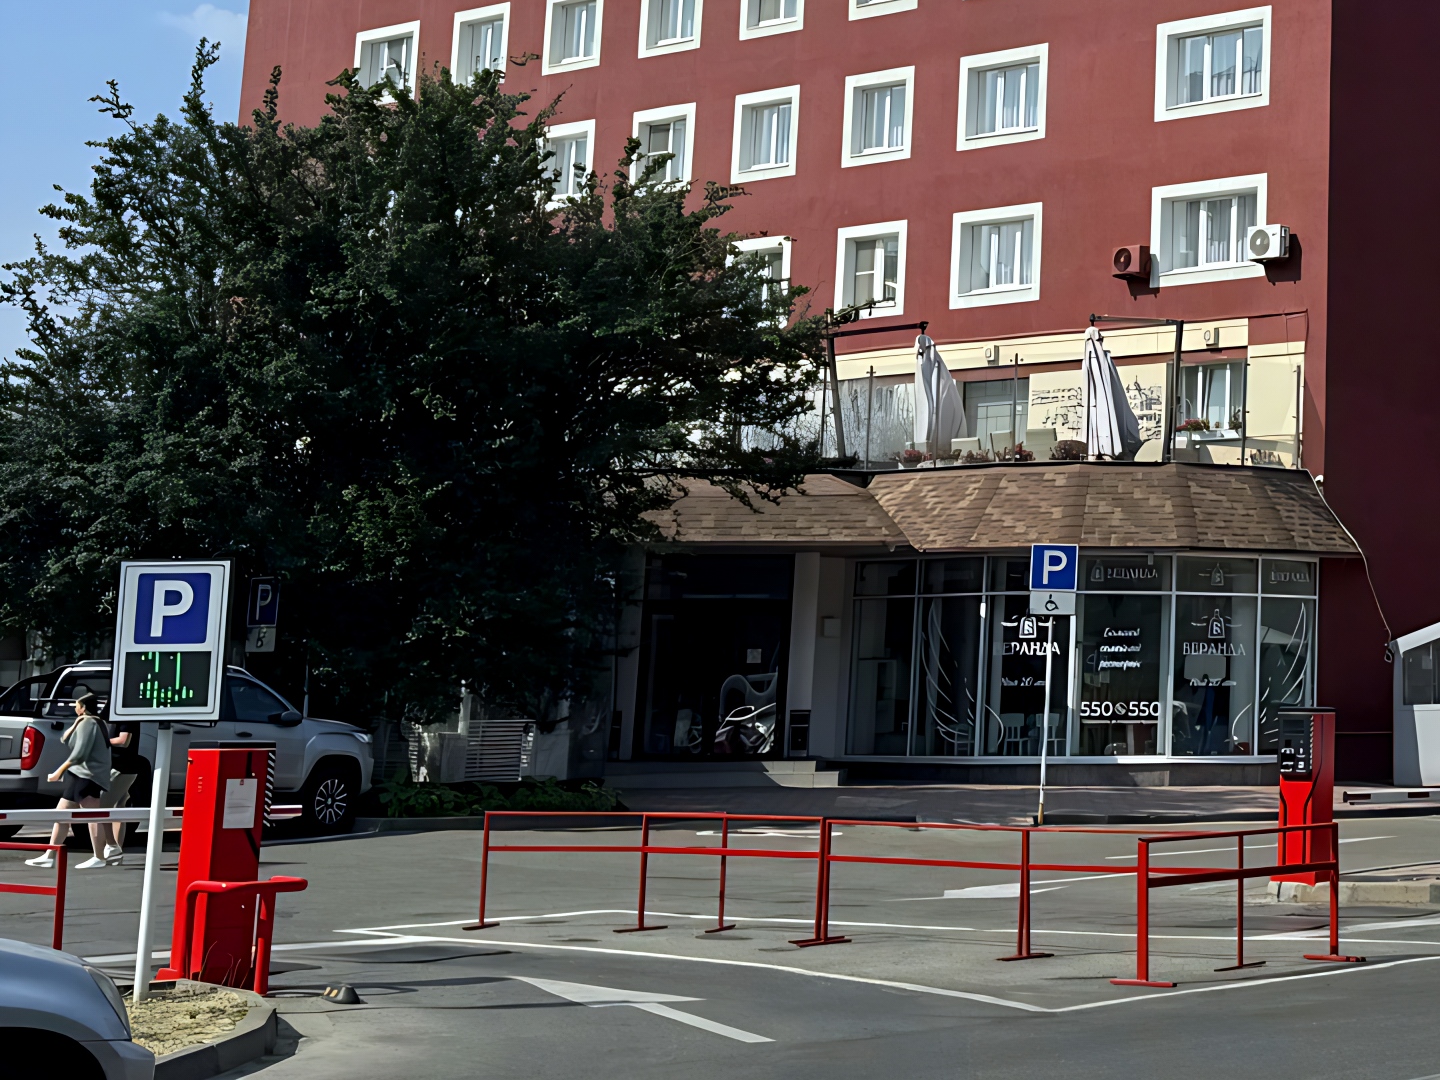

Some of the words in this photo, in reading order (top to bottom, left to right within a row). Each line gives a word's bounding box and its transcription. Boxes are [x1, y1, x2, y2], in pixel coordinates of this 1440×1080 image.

[1042, 550, 1067, 585] P
[150, 580, 194, 637] P
[256, 584, 272, 620] P
[1002, 641, 1061, 656] ЕРАНДА
[1183, 641, 1246, 656] ВЕРАНДА
[1080, 701, 1113, 717] 550
[1128, 701, 1160, 717] 550
